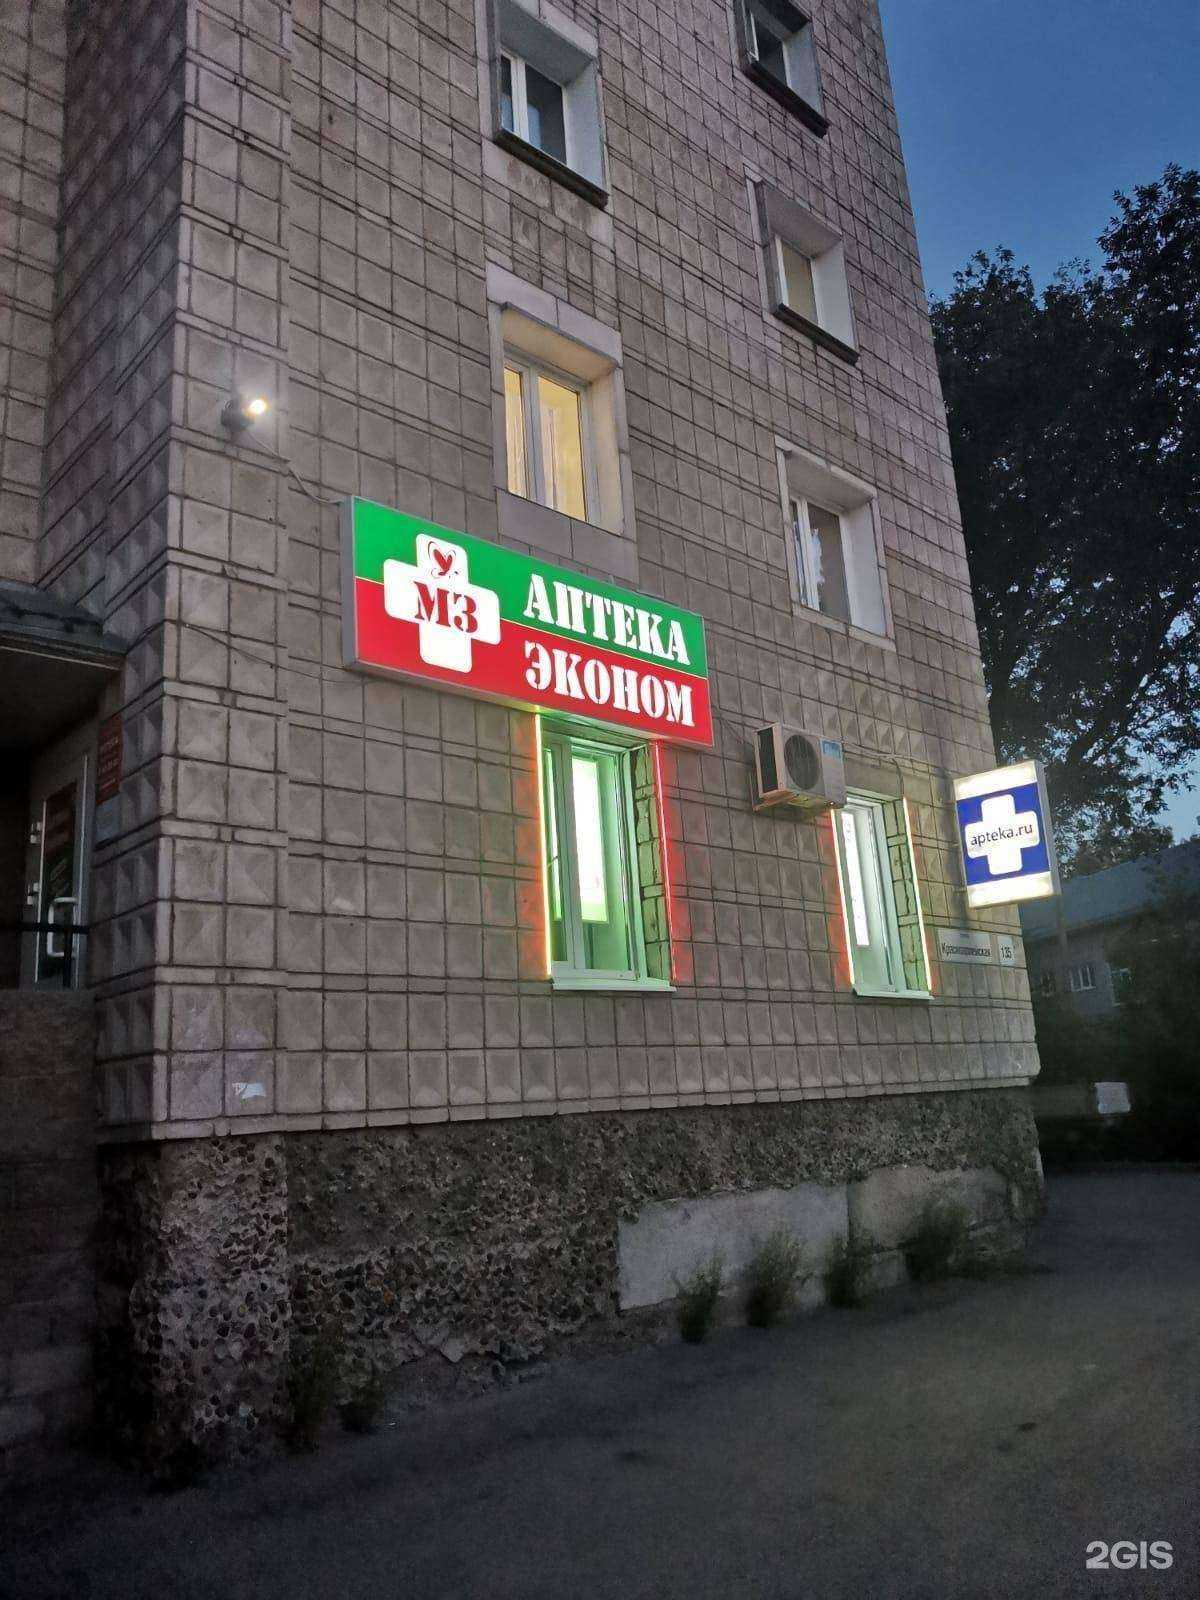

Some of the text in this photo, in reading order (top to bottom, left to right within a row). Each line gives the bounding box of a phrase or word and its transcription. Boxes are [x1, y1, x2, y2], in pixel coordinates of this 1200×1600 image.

[523, 573, 691, 666] АПТЕКА
[523, 640, 696, 728] ЭКОНОМ
[969, 823, 1034, 847] apteka.ru
